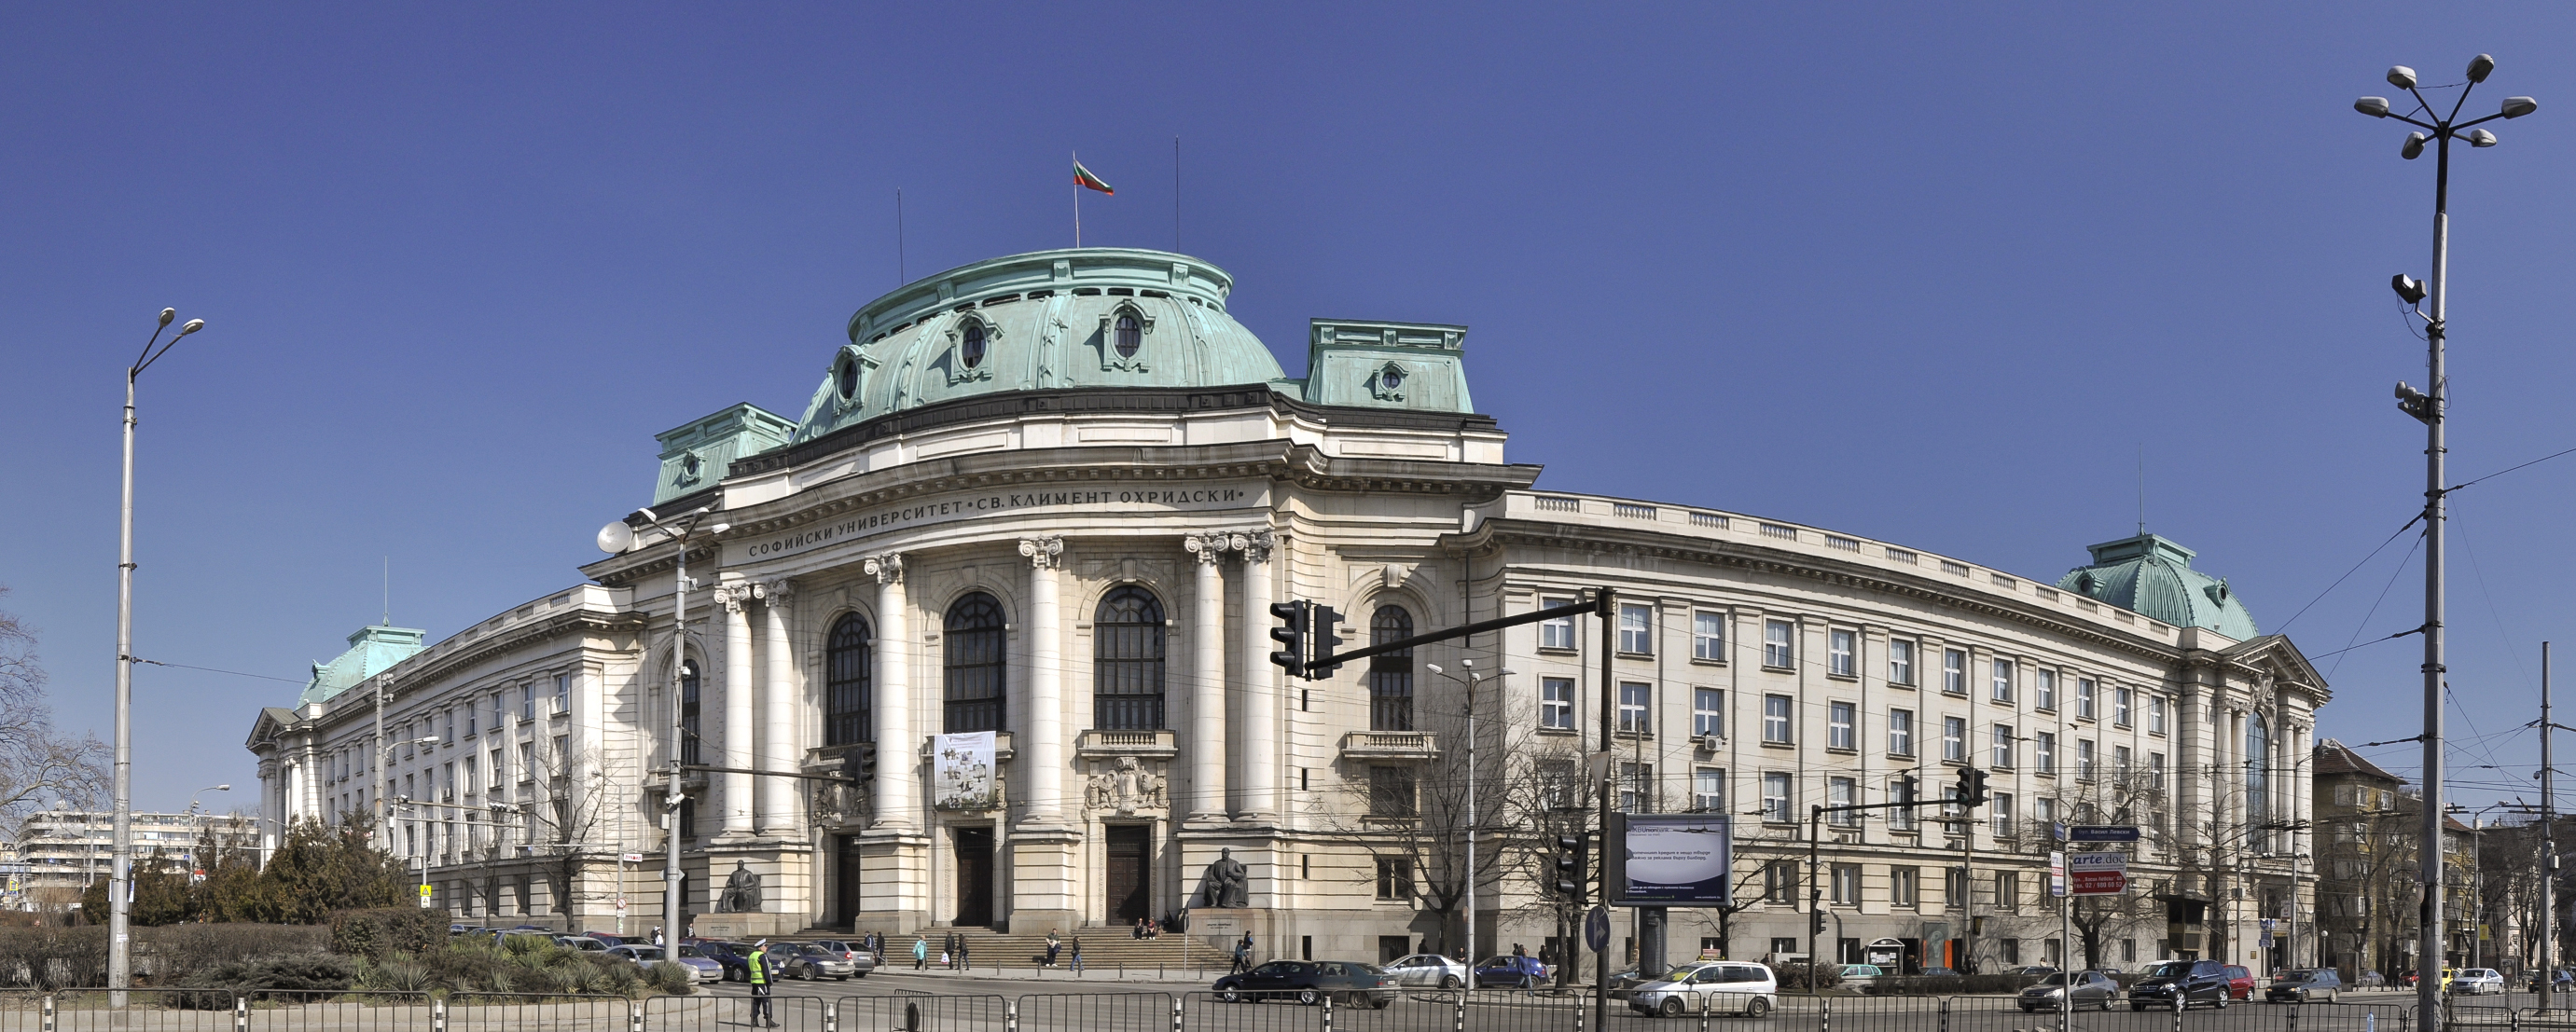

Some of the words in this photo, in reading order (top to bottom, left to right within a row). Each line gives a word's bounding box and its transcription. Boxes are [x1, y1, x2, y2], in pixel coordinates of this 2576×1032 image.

[749, 525, 833, 557] СОФИЙСКИ
[838, 501, 963, 536] УНИВЕРСИТЕТ
[976, 496, 1004, 510] СВ.
[1010, 491, 1112, 507] КЛИМЕНТ
[1119, 488, 1236, 503] ОХРИДСКИ
[2073, 854, 2125, 864] arte.doc
